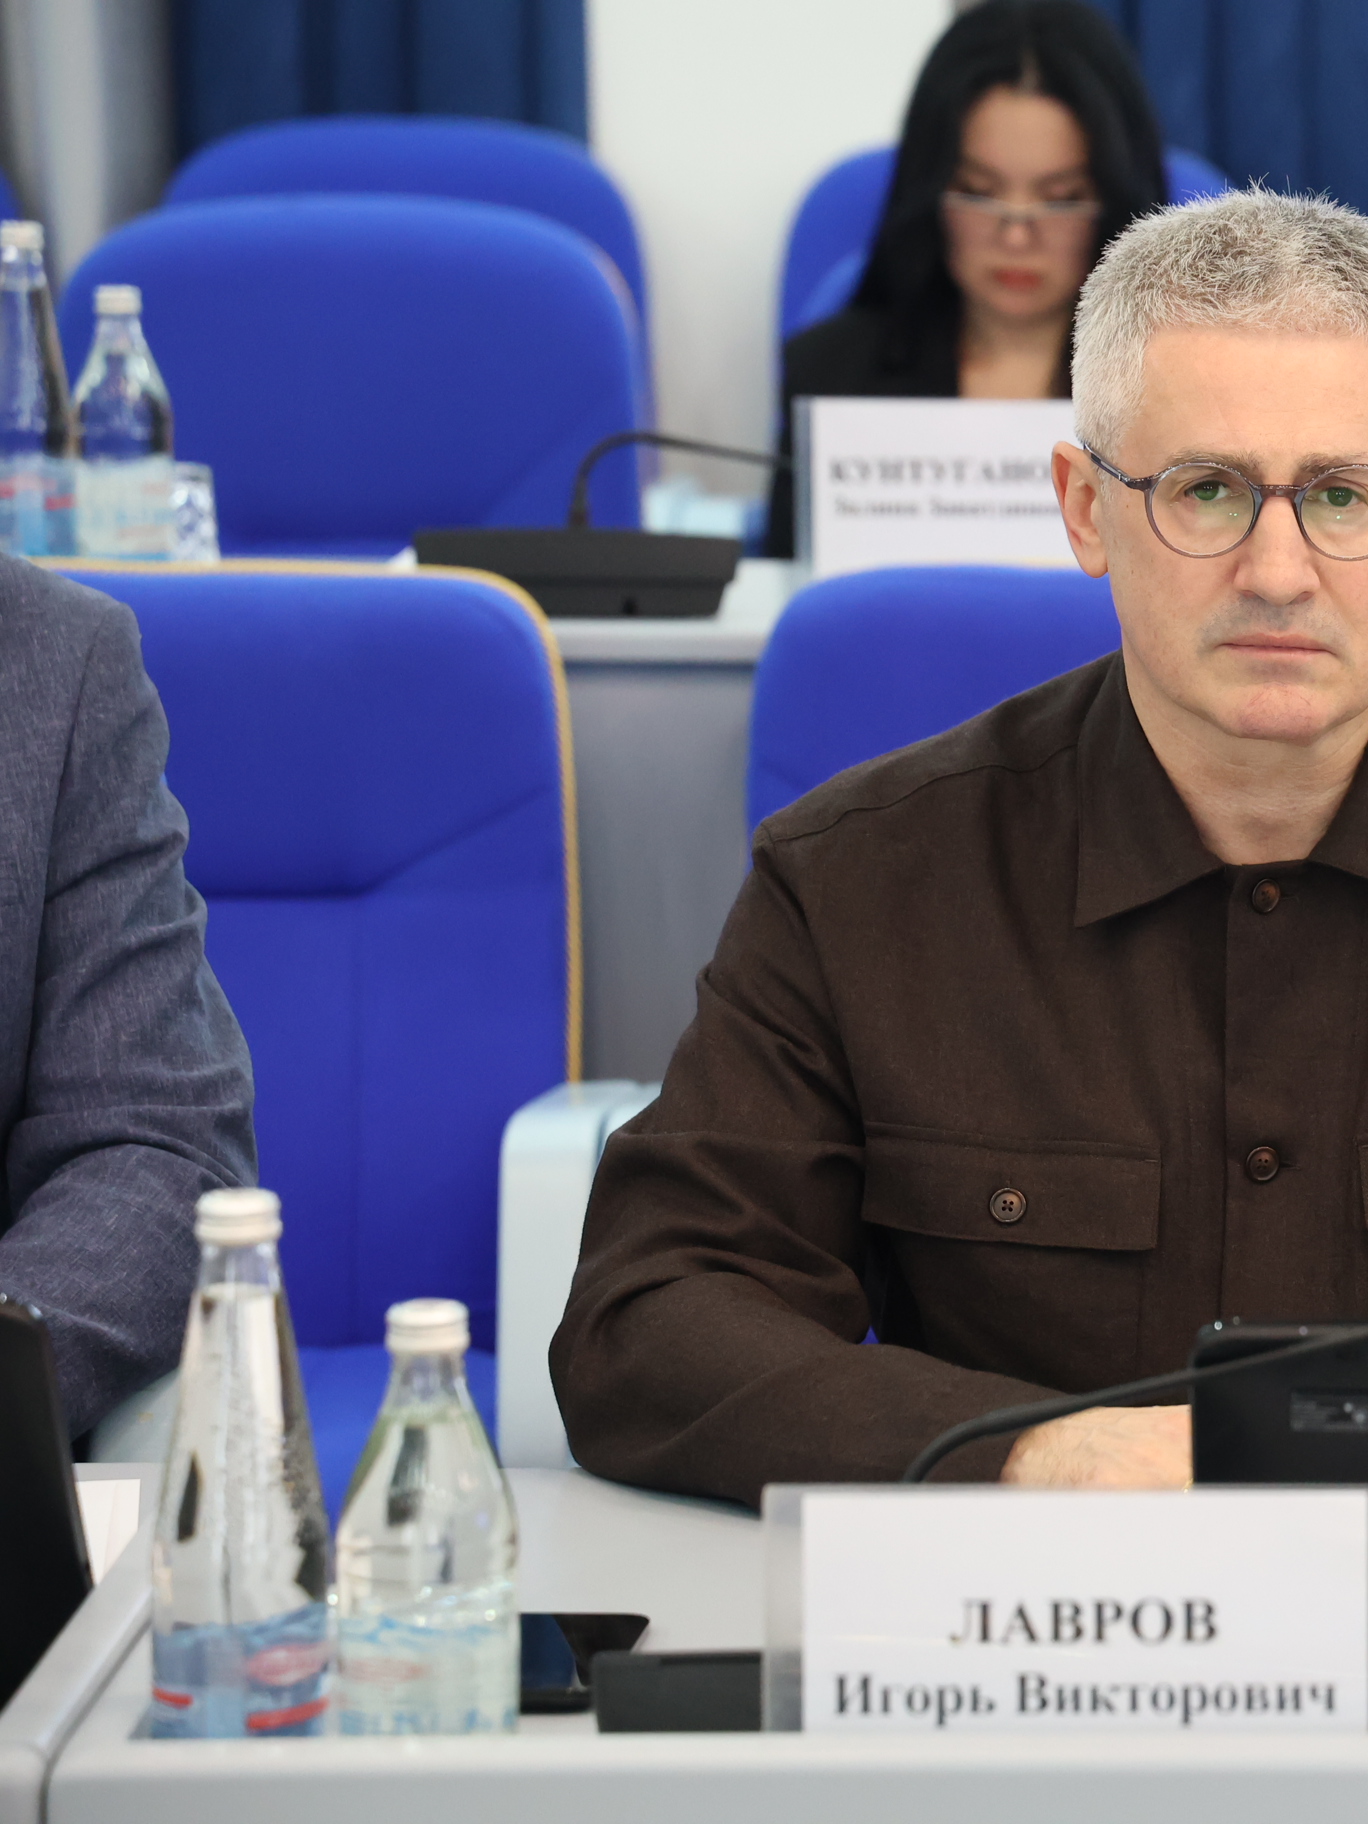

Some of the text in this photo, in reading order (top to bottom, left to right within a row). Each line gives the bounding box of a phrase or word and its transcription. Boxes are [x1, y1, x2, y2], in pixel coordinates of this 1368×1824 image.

[949, 1599, 1219, 1645] ЛАВРОВ
[834, 1673, 1337, 1727] Игорь Викторович
